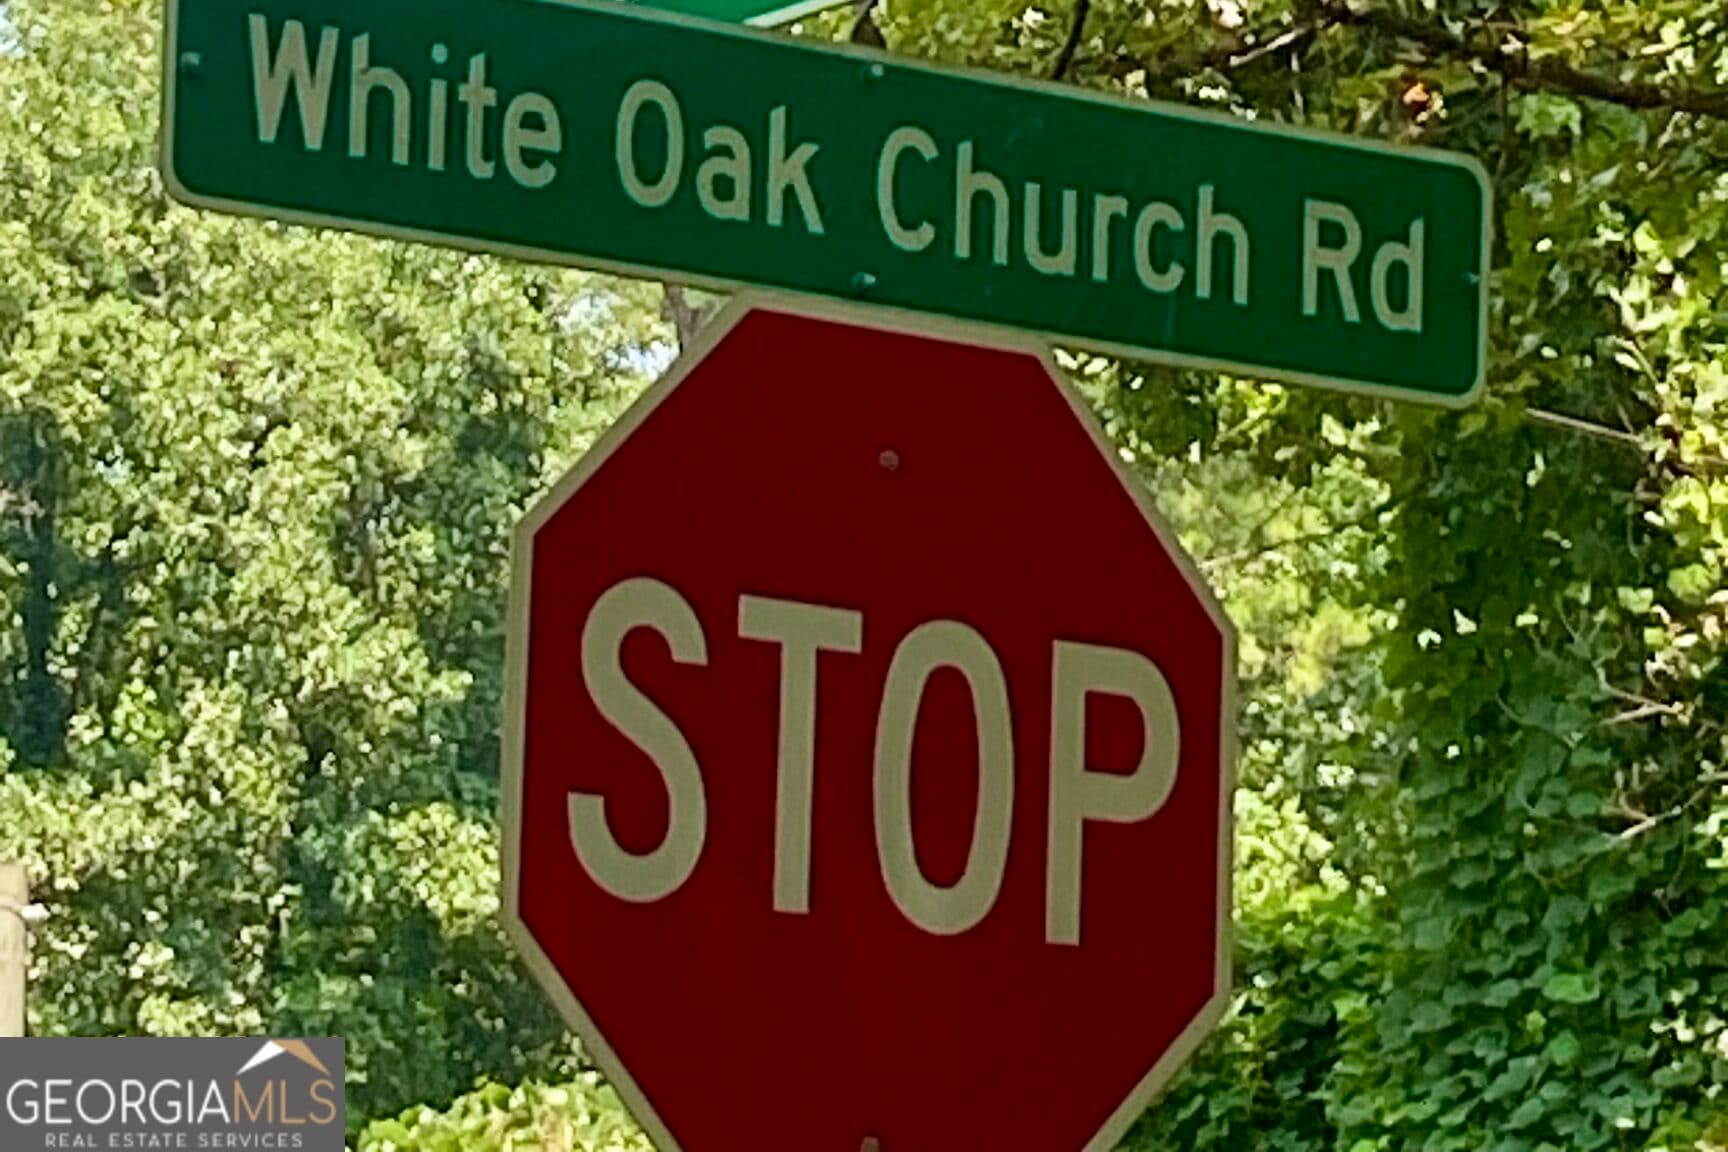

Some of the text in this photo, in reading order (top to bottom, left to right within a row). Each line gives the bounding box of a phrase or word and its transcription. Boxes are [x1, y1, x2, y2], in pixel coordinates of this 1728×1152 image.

[247, 13, 1425, 333] White Oak Church Rd
[566, 576, 1181, 946] STOP
